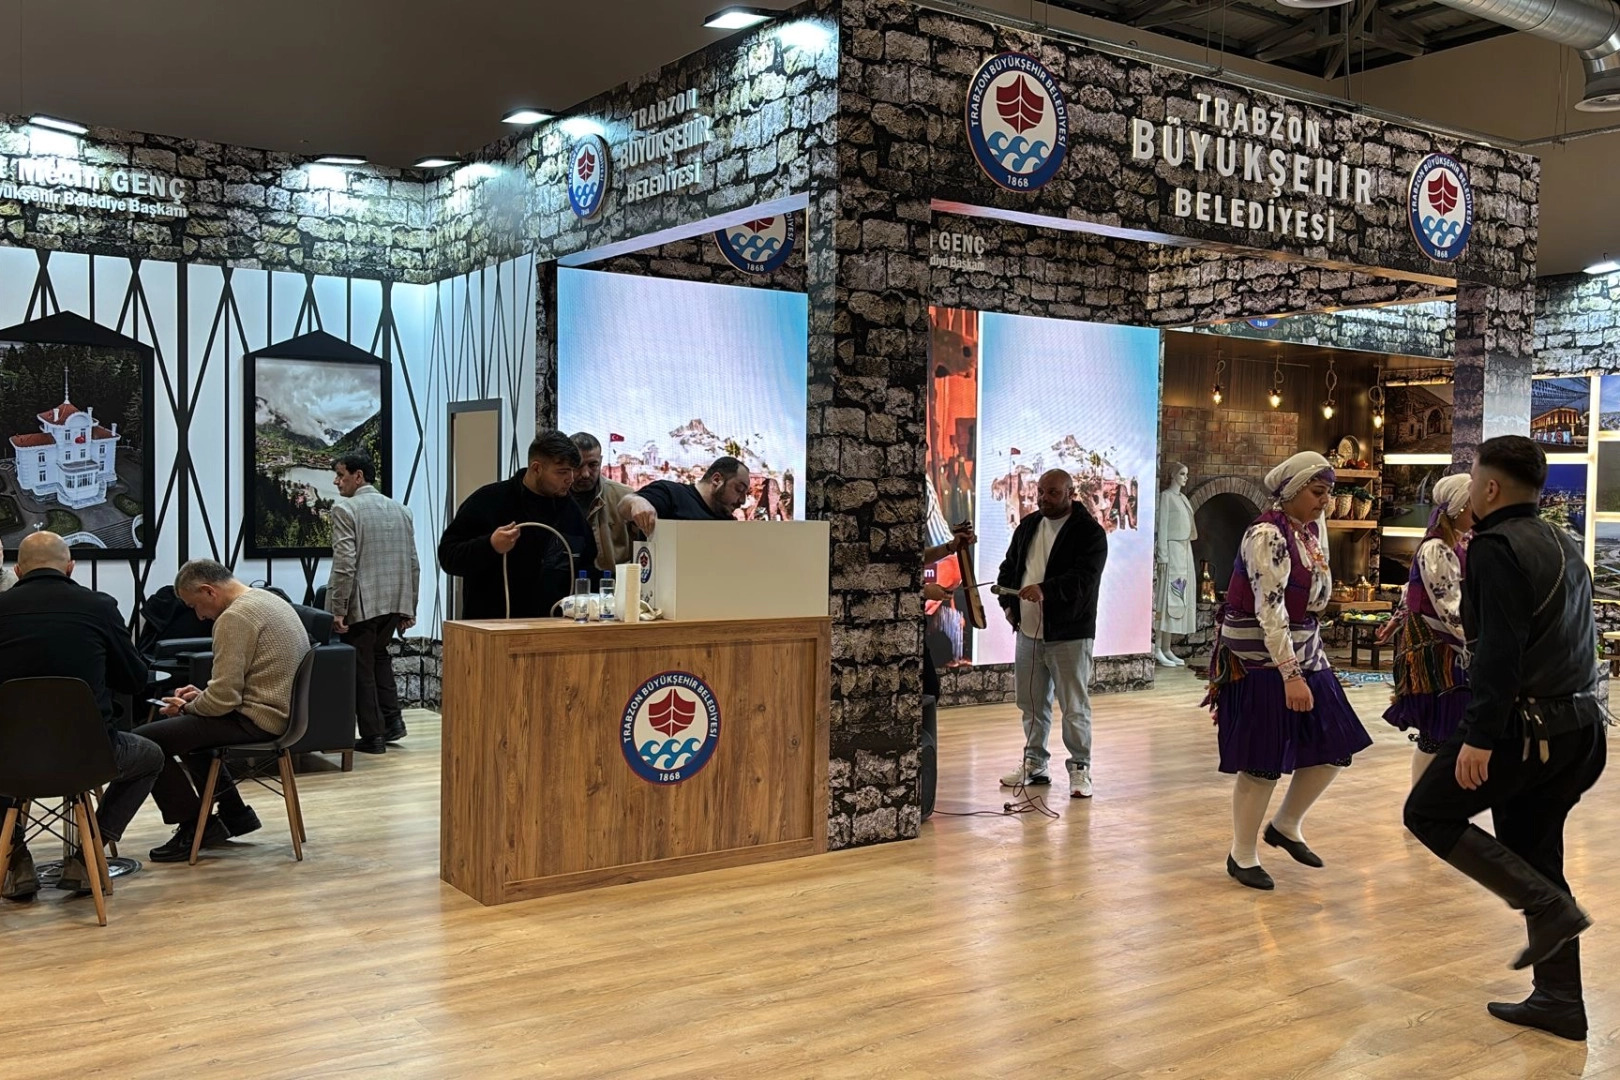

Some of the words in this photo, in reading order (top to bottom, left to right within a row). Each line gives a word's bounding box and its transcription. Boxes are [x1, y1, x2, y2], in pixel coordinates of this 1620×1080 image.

[632, 88, 698, 130] TRABZON
[970, 70, 991, 127] TRABZON
[989, 55, 1046, 82] BÜYÜKŞEHİR
[620, 112, 713, 171] BÜYÜKŞEHİR
[1197, 93, 1320, 149] TRABZON
[627, 158, 702, 203] BELEDİYESİ
[1007, 174, 1029, 187] 1868
[1132, 116, 1372, 205] BÜYÜKŞEHİR
[64, 190, 126, 213] Belediye
[129, 198, 188, 218] Başkanı
[111, 170, 185, 205] GENÇ
[1412, 168, 1425, 213] TRABZON
[1423, 155, 1460, 173] BÜYÜKŞEHİR
[1175, 188, 1335, 243] BELEDİYESİ
[939, 231, 985, 260] GENÇ
[1434, 248, 1448, 258] 1868
[747, 263, 765, 272] 1868
[623, 694, 643, 743] TRABZON
[641, 674, 698, 696] BÜYÜKŞEHİR
[659, 772, 681, 782] 1868
